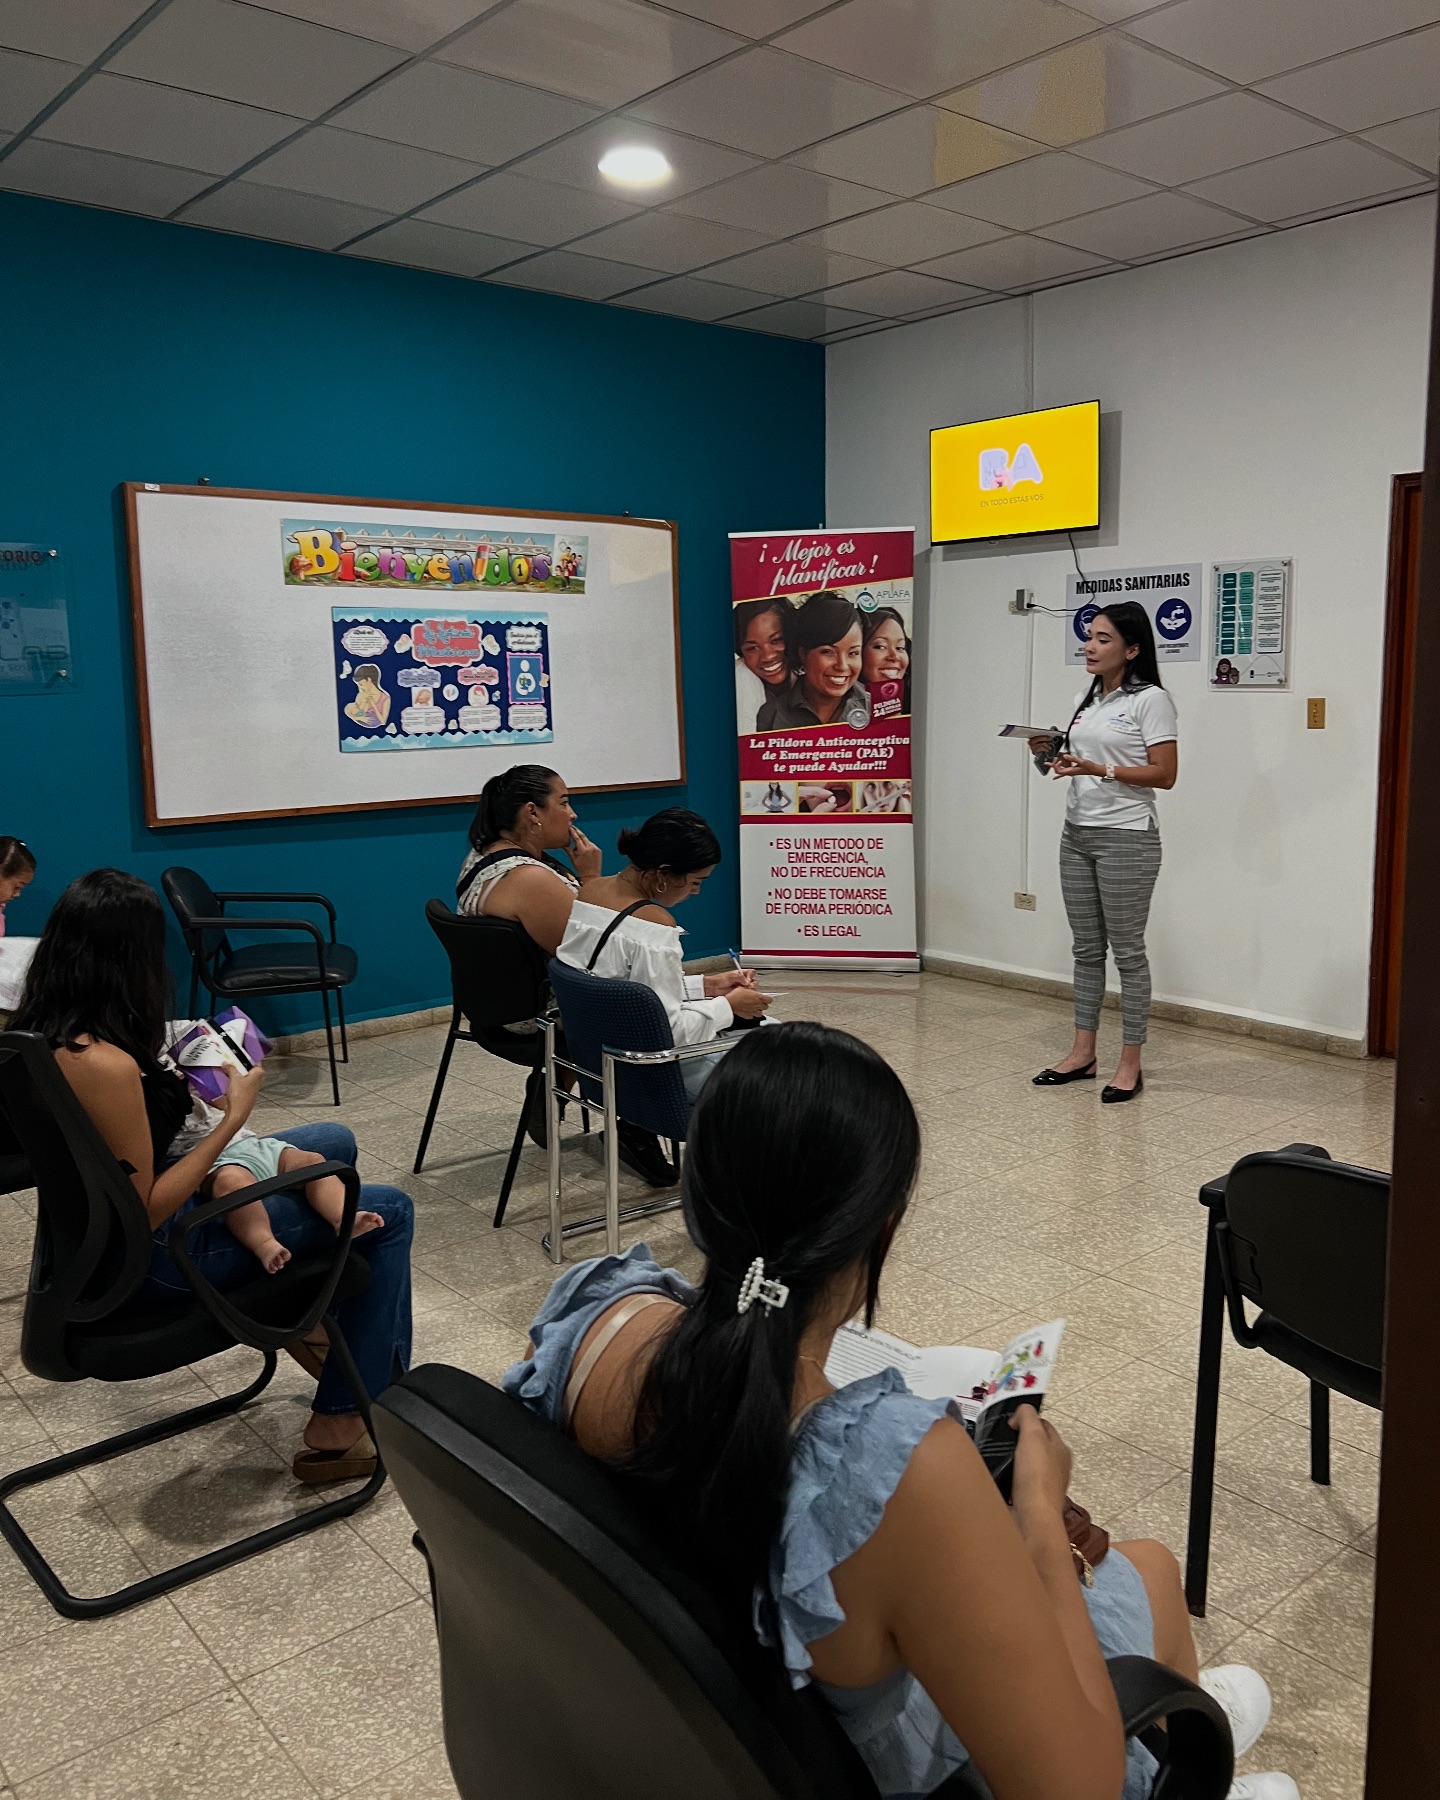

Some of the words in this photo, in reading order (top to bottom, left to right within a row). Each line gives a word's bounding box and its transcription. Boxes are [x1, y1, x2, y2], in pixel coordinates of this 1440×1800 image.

[979, 443, 1043, 492] BA
[293, 529, 553, 584] Bienvenidos
[772, 539, 833, 569] Mejor
[836, 539, 856, 555] es
[770, 558, 867, 595] planificar
[1076, 577, 1122, 594] MEDIDAS
[1125, 572, 1190, 590] SANITARIAS
[877, 590, 910, 598] APLAFA
[750, 739, 765, 748] La
[816, 735, 910, 749] Anticonceptiva
[762, 750, 777, 760] de
[780, 749, 853, 761] Emergencia
[856, 747, 894, 759] (PAE)
[774, 763, 786, 772] te
[789, 763, 825, 773] puede
[828, 761, 887, 773] Ayudar!!!
[776, 838, 792, 849] ES
[795, 838, 810, 849] UN
[813, 838, 865, 849] METODO
[867, 838, 884, 849] DE
[787, 852, 868, 865] EMERGENCIA,
[771, 867, 789, 878] NO
[791, 867, 807, 878] DE
[810, 867, 885, 878] FRECUENCIA
[775, 889, 792, 899] NO
[795, 889, 826, 899] DEBE
[829, 888, 887, 900] TOMARSE
[766, 904, 781, 914] DE
[784, 903, 826, 915] FORMA
[828, 901, 893, 915] PERIÓDICA
[804, 926, 819, 937] ES
[822, 926, 861, 937] LEGAL
